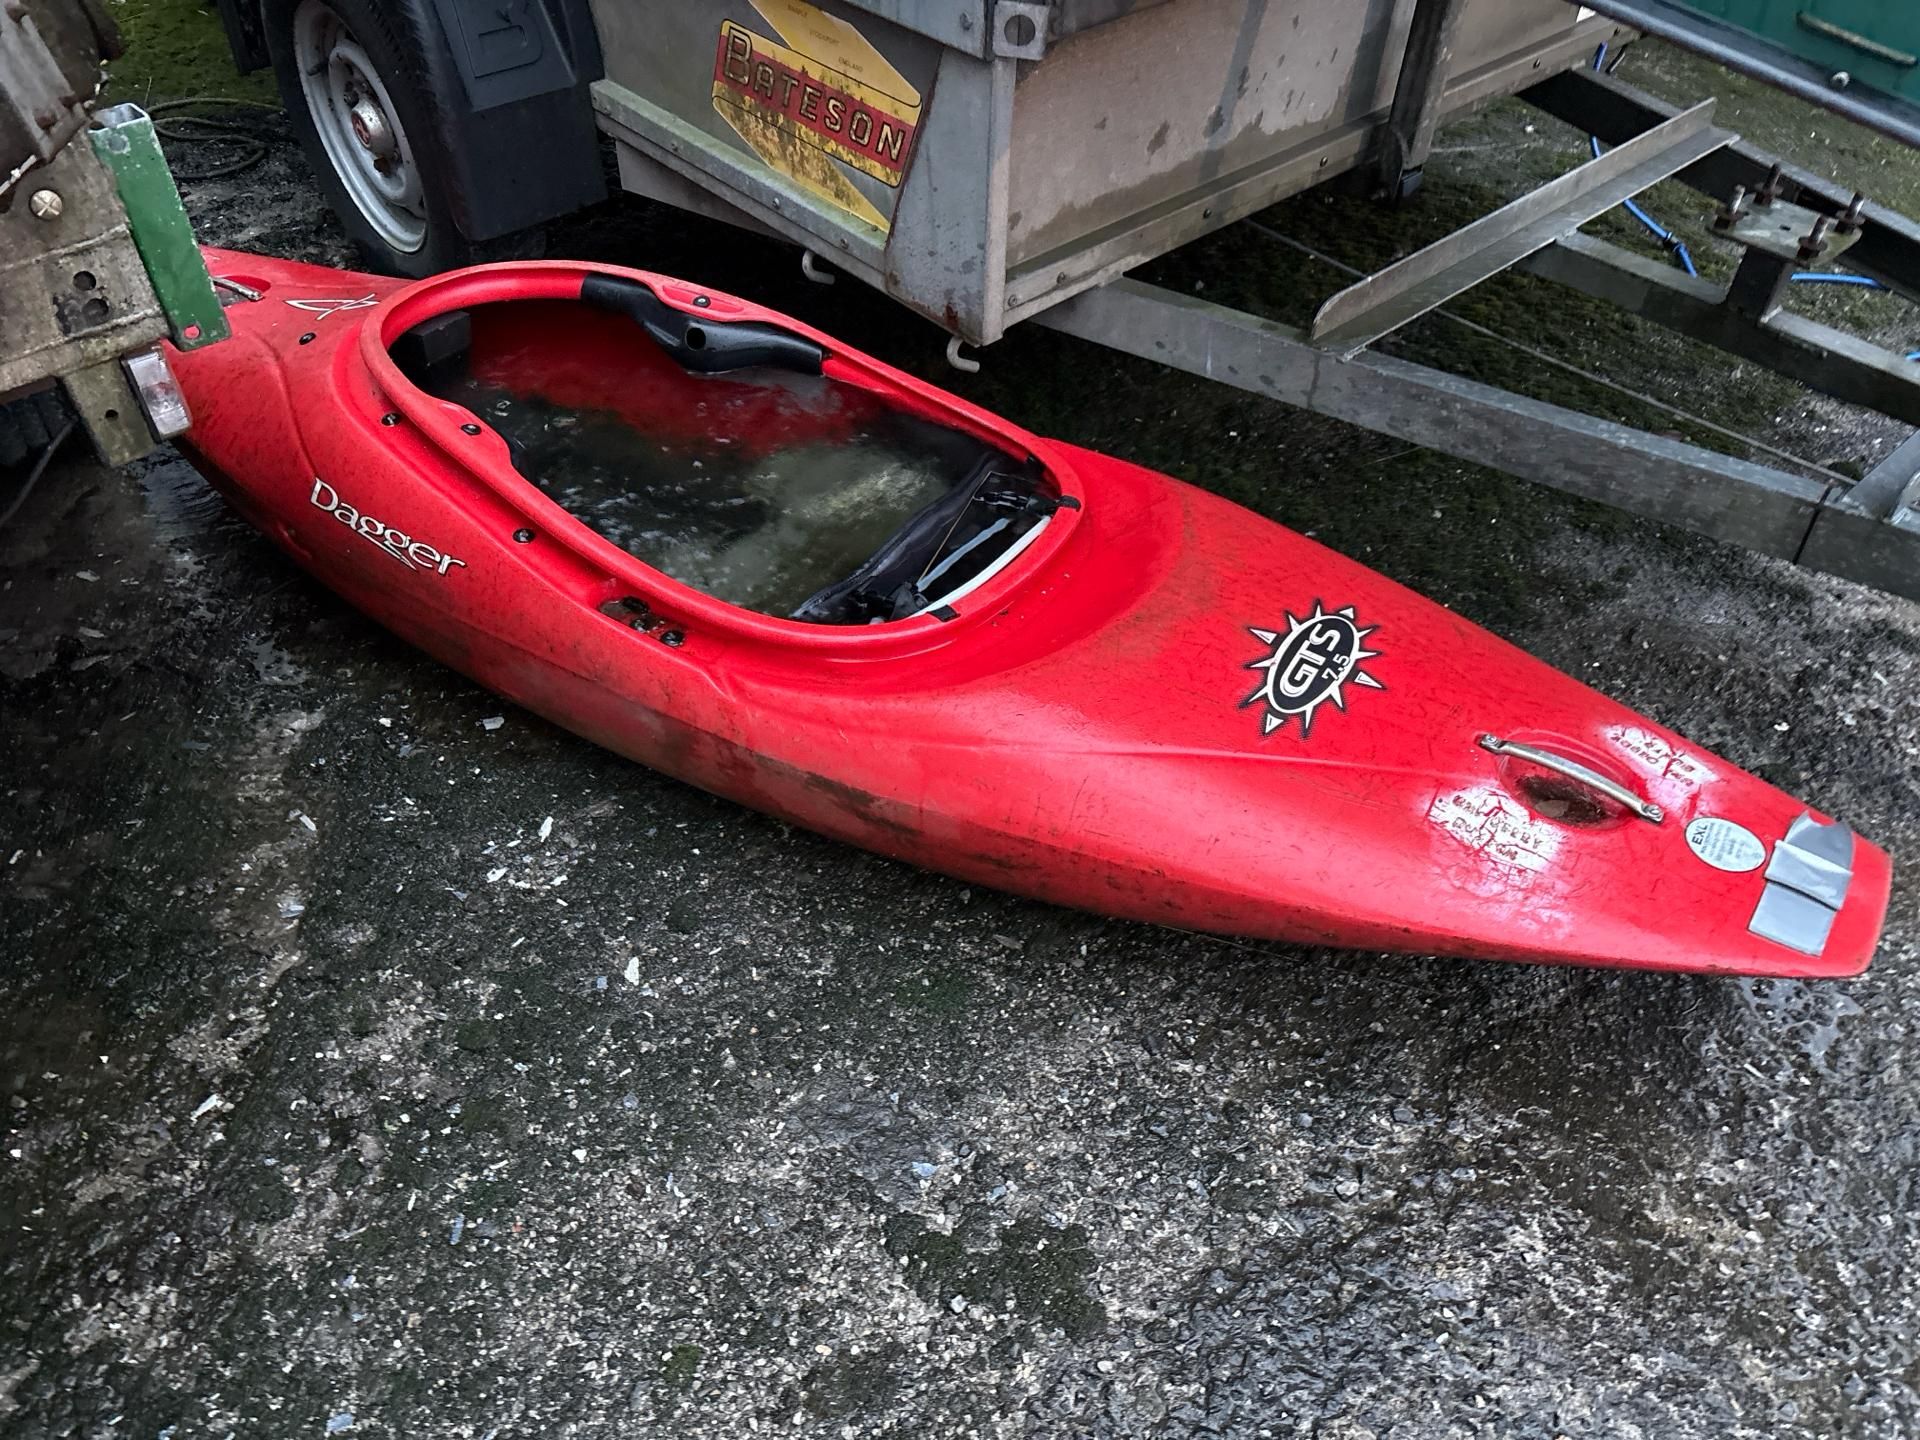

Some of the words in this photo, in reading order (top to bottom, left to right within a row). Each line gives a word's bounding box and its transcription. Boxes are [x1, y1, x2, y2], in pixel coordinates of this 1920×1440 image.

[310, 476, 467, 575] Dagger
[1278, 622, 1342, 698] GTS
[1692, 824, 1708, 845] EXL
